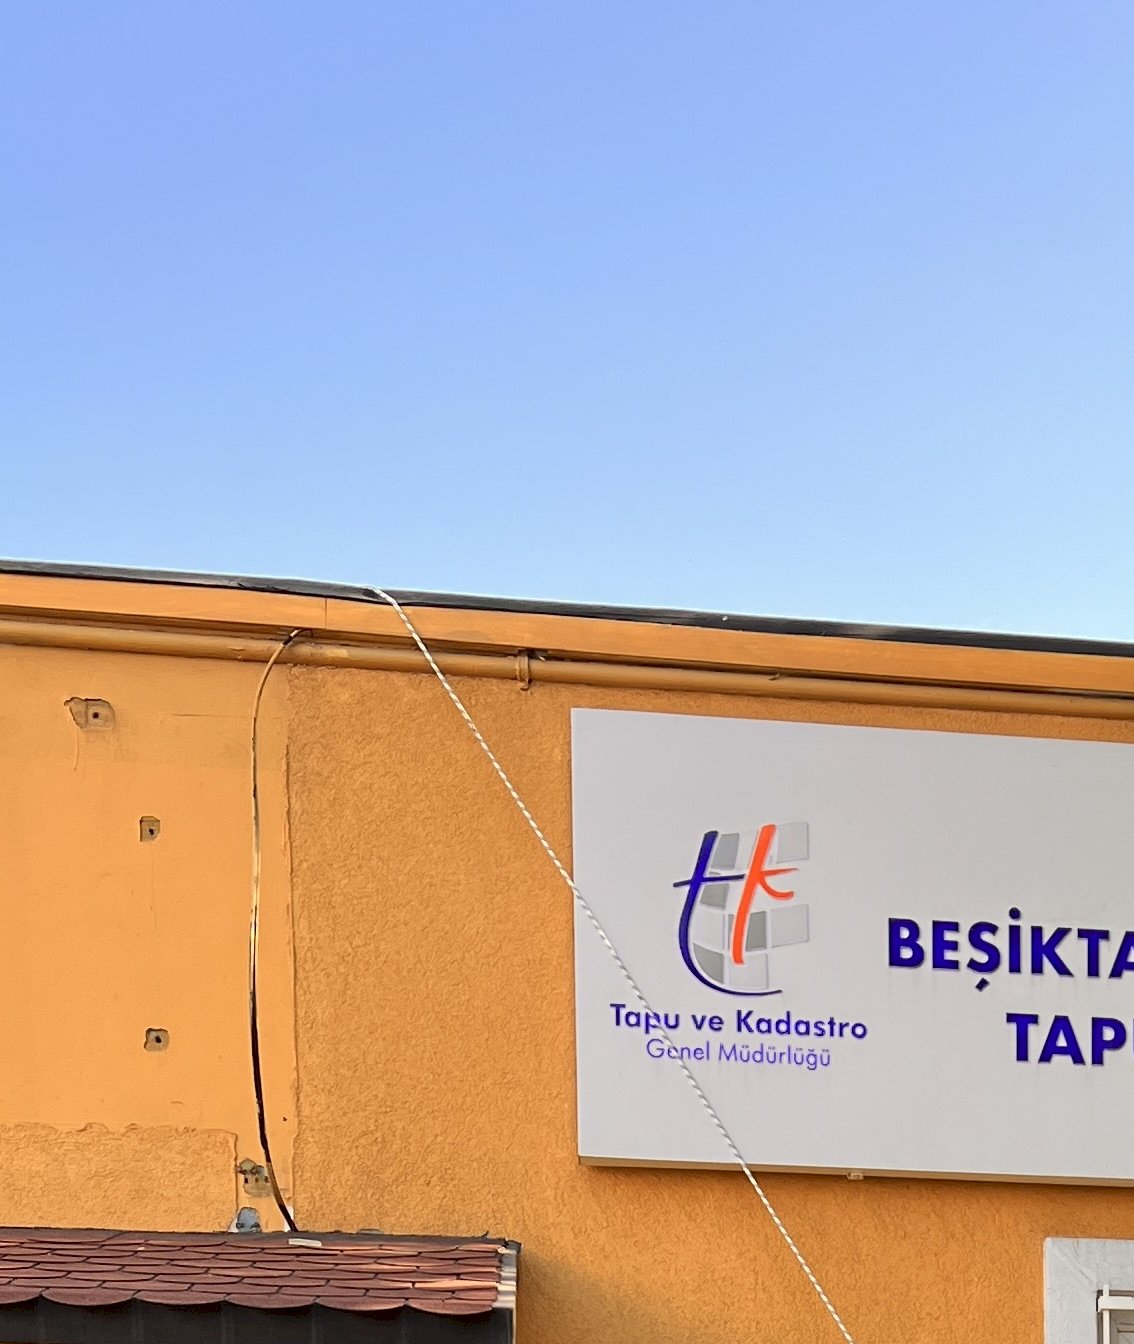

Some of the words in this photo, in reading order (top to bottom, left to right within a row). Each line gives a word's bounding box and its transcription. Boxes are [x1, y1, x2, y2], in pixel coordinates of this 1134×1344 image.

[610, 1003, 680, 1034] Tapu
[691, 1014, 725, 1032] ve
[736, 1009, 868, 1040] Kadastro
[646, 1038, 710, 1062] Genel
[718, 1042, 831, 1071] Müdürlüğü
